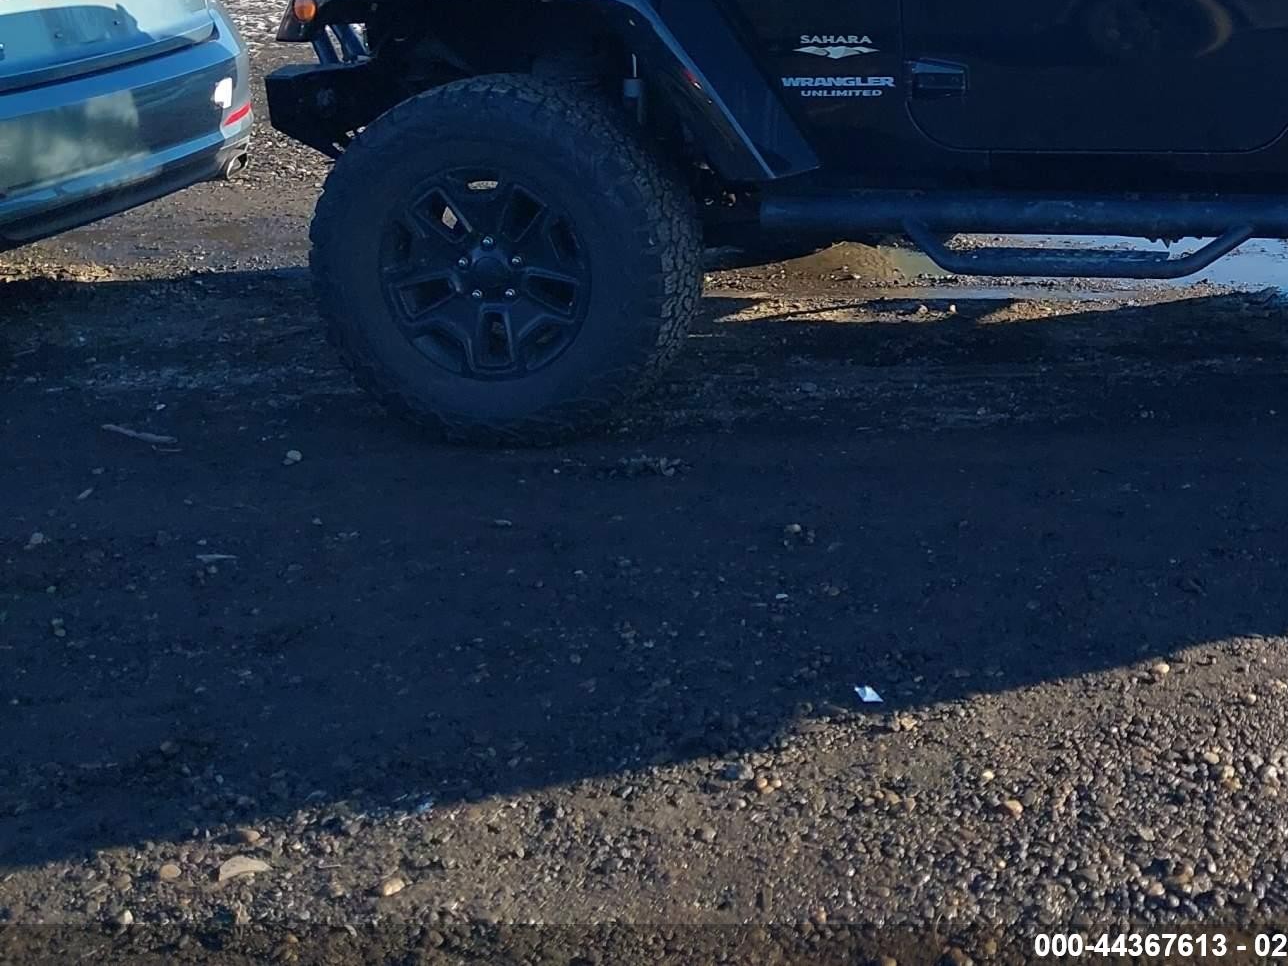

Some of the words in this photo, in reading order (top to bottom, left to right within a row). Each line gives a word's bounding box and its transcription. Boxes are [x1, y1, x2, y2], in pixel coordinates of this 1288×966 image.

[800, 35, 873, 44] SAHARA
[781, 76, 896, 87] WRANGLER
[801, 89, 882, 97] UNLIMITED
